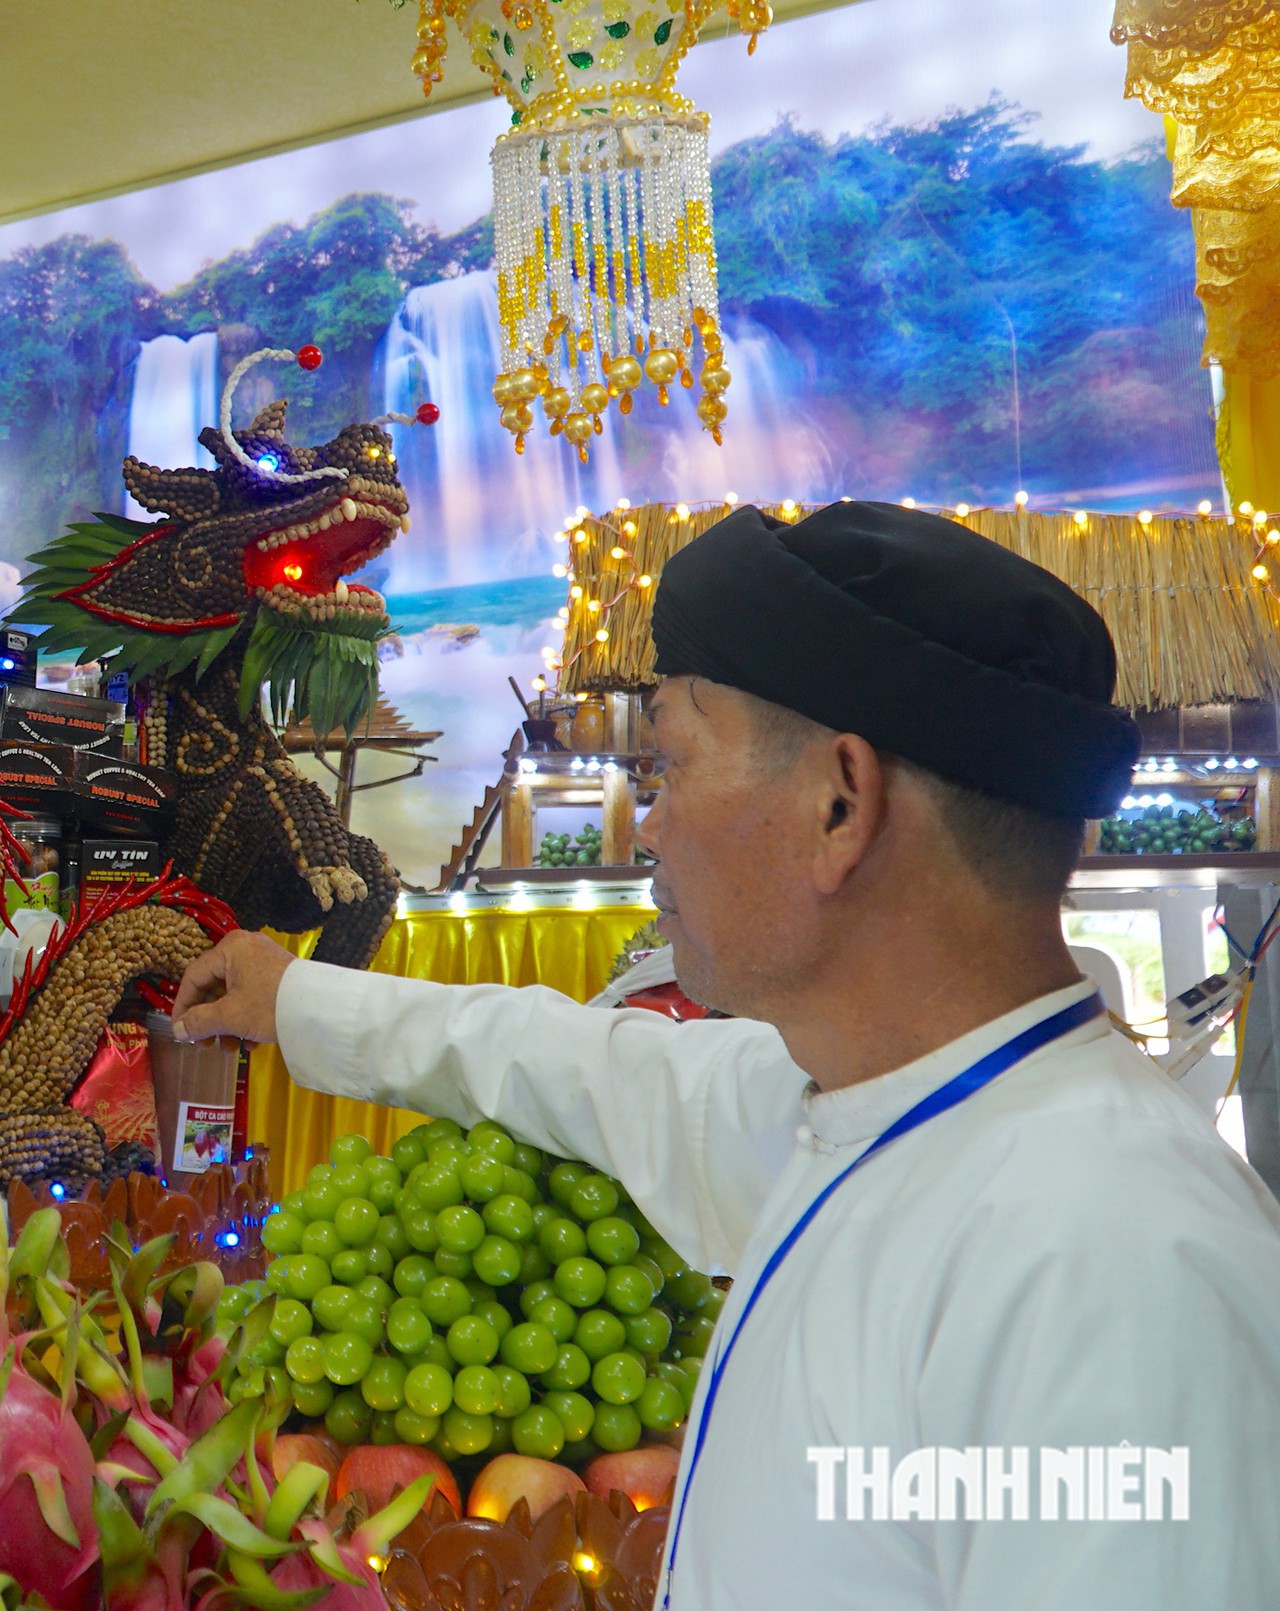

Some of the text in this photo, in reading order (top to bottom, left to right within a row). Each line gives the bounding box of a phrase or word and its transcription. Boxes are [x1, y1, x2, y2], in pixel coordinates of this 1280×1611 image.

[26, 711, 106, 732] ROBUST SPECIAL
[42, 756, 52, 766] TEA
[24, 774, 58, 786] SPECIAL
[125, 769, 147, 782] HEALTHY
[146, 779, 156, 789] TEA
[90, 785, 160, 808] ROBUST SPECIAL
[93, 850, 149, 860] UY TÍN
